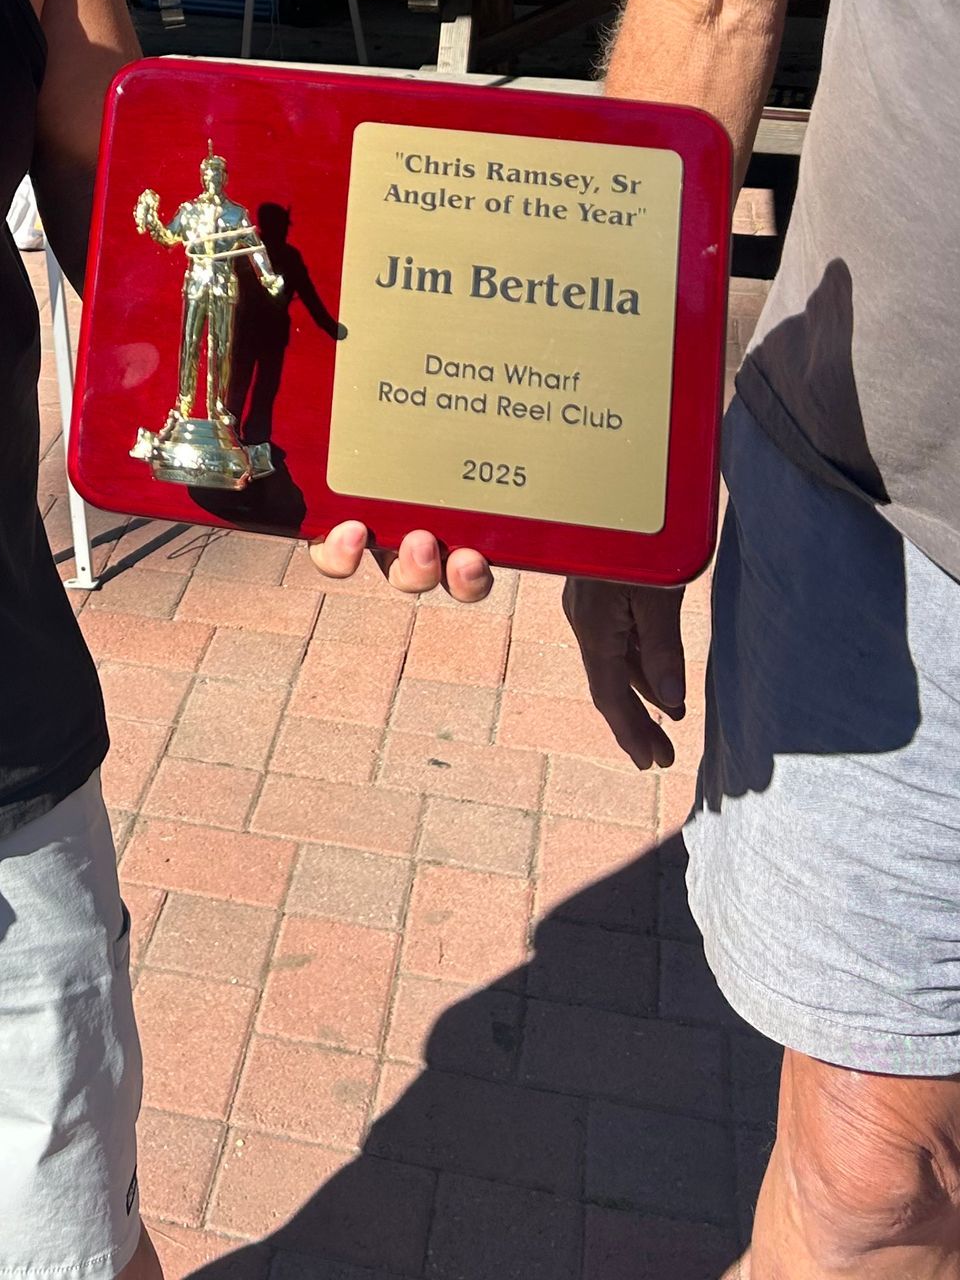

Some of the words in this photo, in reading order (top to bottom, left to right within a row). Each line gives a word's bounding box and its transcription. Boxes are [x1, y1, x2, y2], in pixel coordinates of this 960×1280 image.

[396, 152, 476, 179] "Chris
[487, 162, 600, 197] Ramsey,
[612, 175, 642, 195] Sr
[384, 184, 476, 212] Angler
[485, 195, 515, 215] of
[523, 198, 568, 220] the
[578, 203, 647, 227] Year"
[376, 256, 453, 295] Jim
[470, 265, 641, 316] Bertella
[426, 355, 494, 382] Dana
[504, 364, 581, 392] Wharf
[379, 382, 427, 407] Rod
[437, 394, 487, 414] and
[497, 396, 551, 422] Reel
[562, 404, 623, 431] Club
[463, 460, 527, 488] 2025
